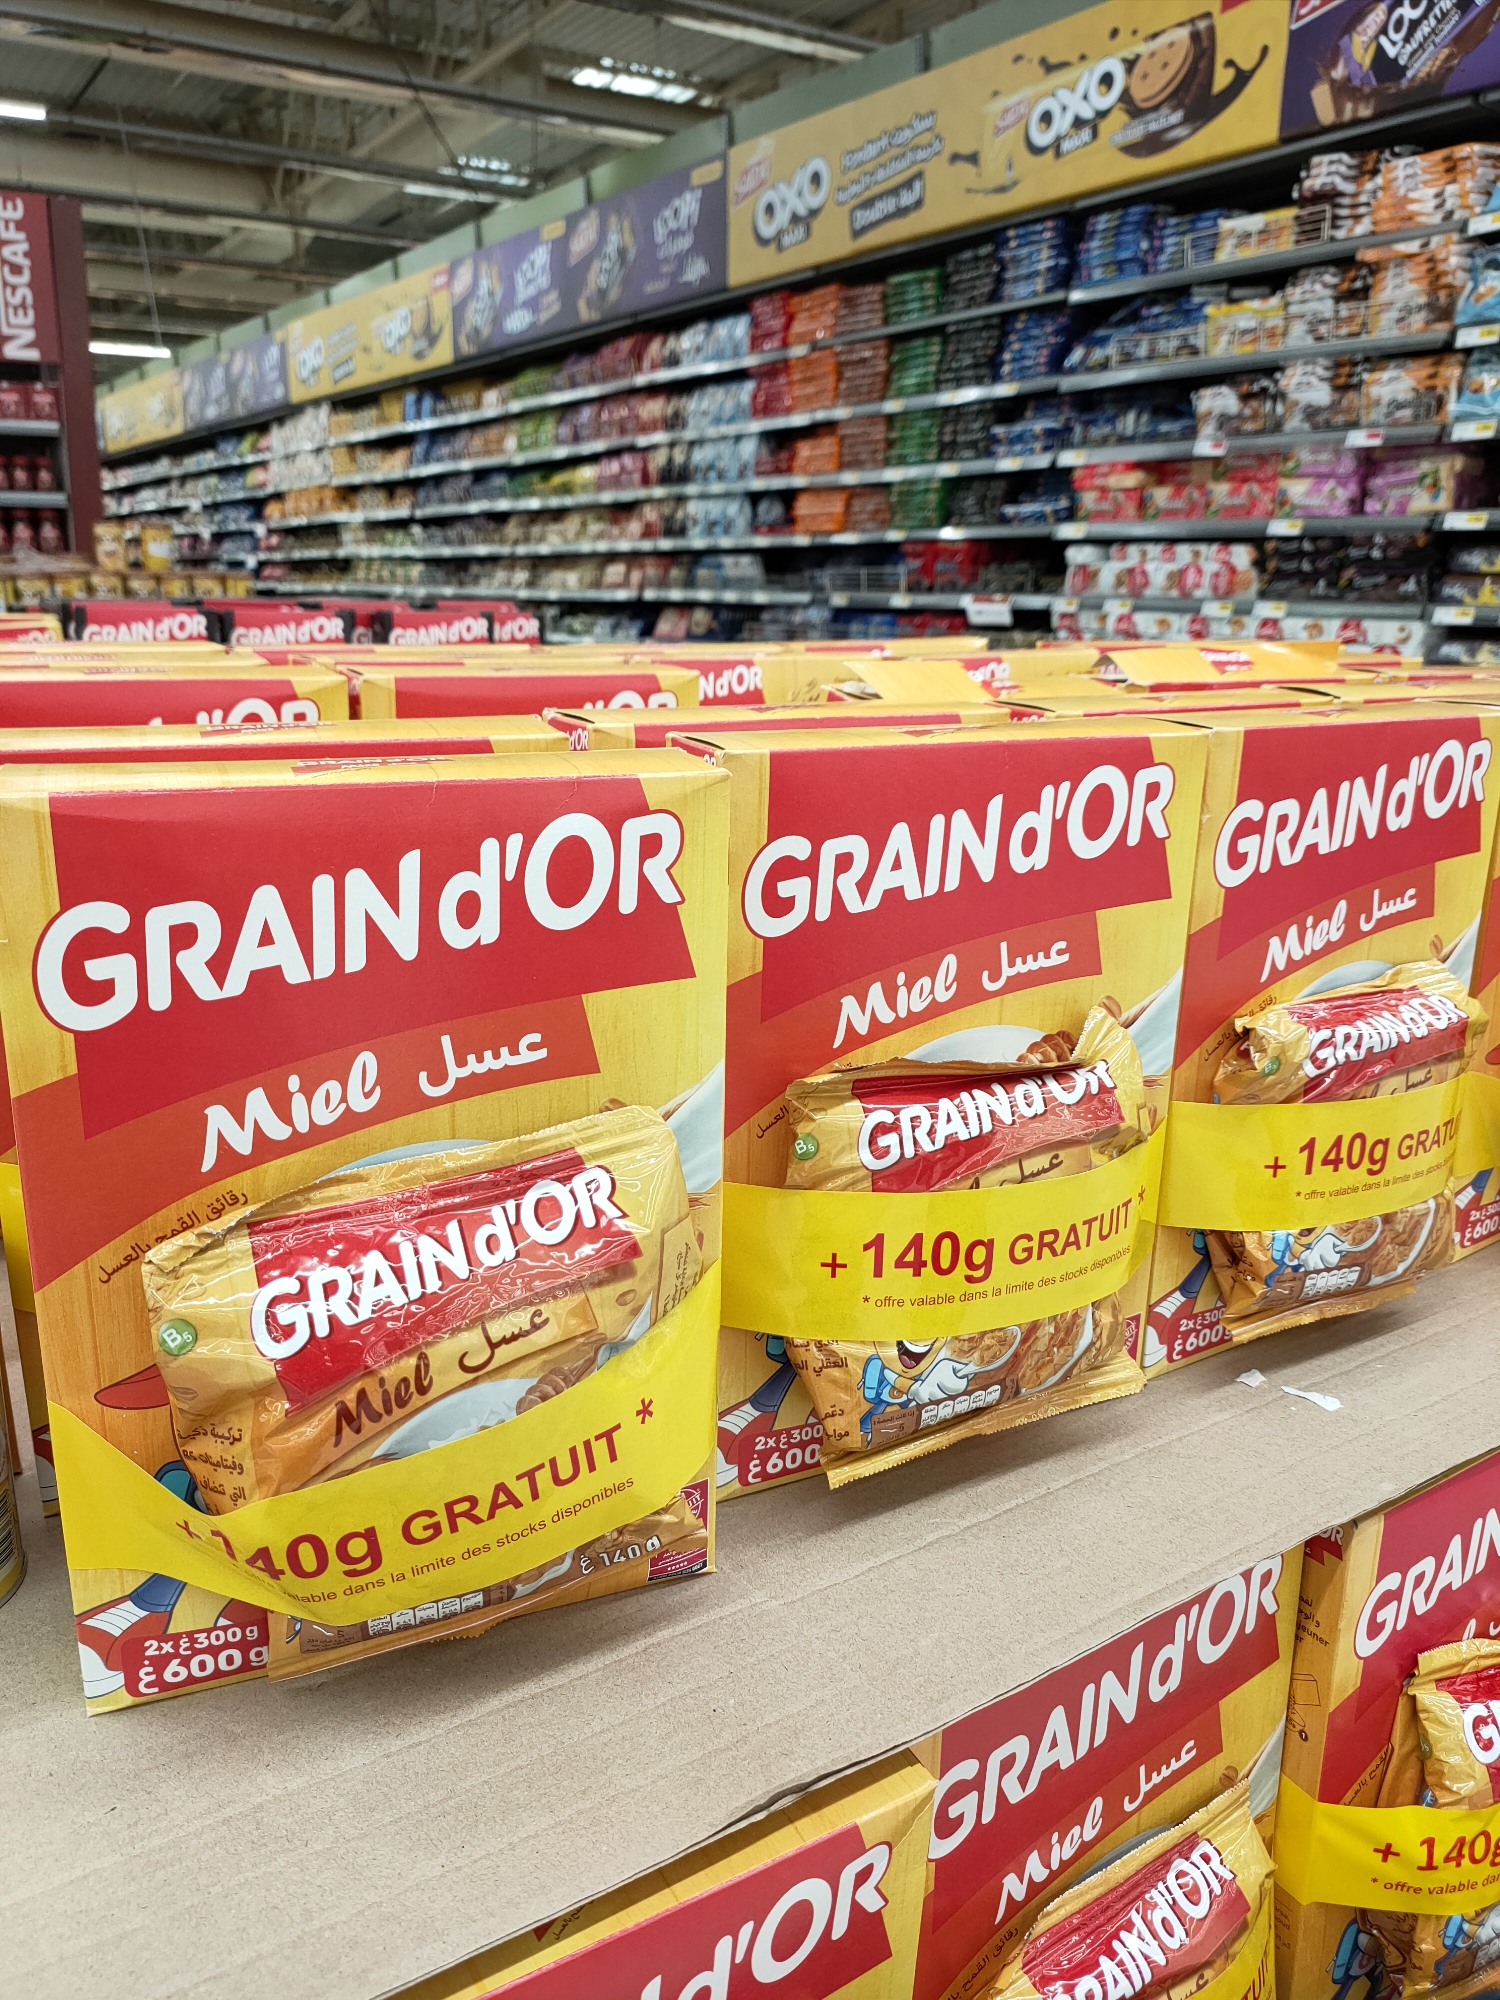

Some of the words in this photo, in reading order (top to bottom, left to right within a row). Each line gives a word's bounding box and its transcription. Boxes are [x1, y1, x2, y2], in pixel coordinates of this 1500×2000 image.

[1027, 55, 1126, 148] OXO
[755, 156, 831, 240] OXO
[83, 618, 153, 641] GRAIN
[231, 620, 295, 646] GRAIN
[389, 622, 448, 645] GRAIN
[715, 664, 763, 697] d'OR
[1214, 763, 1388, 889] GRAIN
[1385, 738, 1492, 832] d'OR
[743, 793, 1004, 938] GRAIN
[1008, 763, 1175, 874] d'OR
[36, 848, 421, 1032] GRAIN
[438, 811, 684, 950] d'OR
[1260, 899, 1347, 983] Miel
[1359, 887, 1417, 932] عسل
[981, 940, 1071, 991] عسل
[833, 953, 958, 1049] Miel
[418, 1031, 549, 1098] عسل
[1302, 1010, 1411, 1078] GRAIN
[200, 1050, 382, 1173] Miel
[756, 1105, 789, 1139] العسل
[857, 1082, 1015, 1171] GRAIN
[1298, 1132, 1390, 1176] 140g
[206, 1189, 248, 1222] رقائق
[1304, 1189, 1326, 1200] offre
[1328, 1183, 1360, 1198] valable
[1361, 1181, 1381, 1192] dans
[862, 1230, 995, 1284] 140g
[1008, 1197, 1133, 1266] GRATUIT
[1473, 1215, 1499, 1239] 600
[251, 1221, 470, 1361] GRAIN
[475, 1166, 625, 1268] d'OR
[874, 1295, 905, 1308] offre
[909, 1293, 955, 1307] valable
[959, 1289, 988, 1303] dans
[991, 1286, 1001, 1298] la
[1005, 1279, 1035, 1296] limite
[1037, 1275, 1056, 1289] des
[1058, 1265, 1089, 1283] stocks
[1090, 1245, 1131, 1273] disponibles
[457, 1308, 550, 1374] عسل
[1172, 1335, 1183, 1361] غ
[1185, 1324, 1223, 1352] 600
[1179, 1319, 1195, 1332] 2x
[333, 1351, 434, 1448] Miel
[747, 1454, 762, 1484] غ
[766, 1443, 821, 1474] 600
[755, 1436, 777, 1451] 2x
[789, 1424, 824, 1443] 300
[401, 1422, 622, 1547] GRATUIT
[343, 1576, 386, 1597] dans
[390, 1571, 407, 1584] la
[411, 1553, 456, 1578] limite
[461, 1542, 491, 1561] des
[496, 1517, 547, 1548] stocks
[550, 1476, 635, 1525] disponibles
[600, 1544, 642, 1567] 140
[138, 1660, 159, 1694] غ
[163, 1648, 243, 1683] 600
[249, 1645, 268, 1667] g
[143, 1639, 175, 1657] 2x
[179, 1634, 192, 1655] غ
[194, 1627, 242, 1649] 300
[246, 1625, 258, 1641] g
[928, 1641, 1145, 1862] GRAIN
[1148, 1554, 1285, 1705] d'OR
[1123, 1735, 1198, 1813] عسل
[993, 1795, 1104, 1926] Miel
[1383, 1881, 1423, 1895] offre
[1428, 1878, 1478, 1895] valable
[1146, 1839, 1236, 1950] d'OR
[961, 1954, 990, 1992] القمح
[992, 1927, 1019, 1958] رقائق
